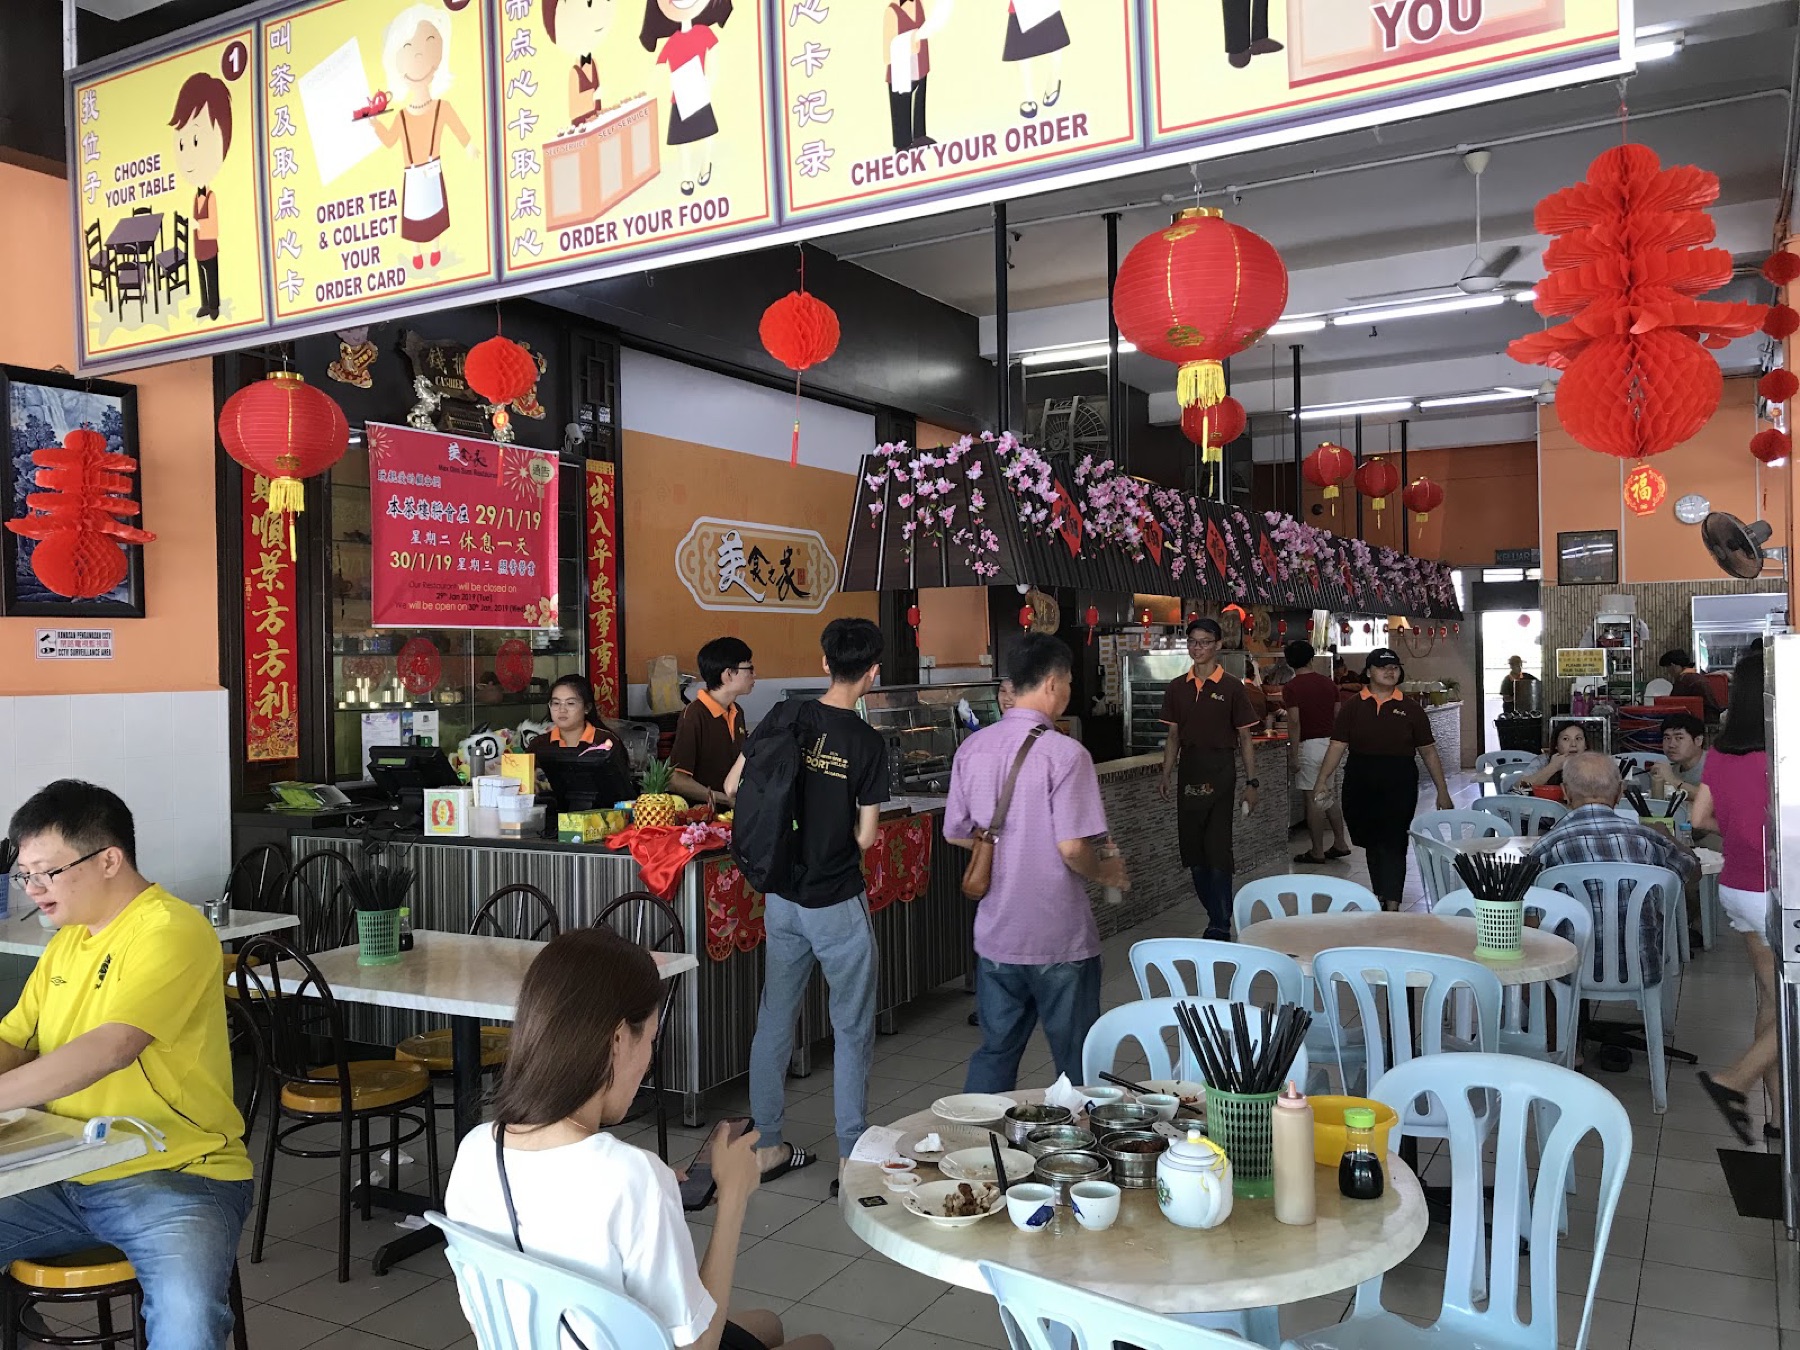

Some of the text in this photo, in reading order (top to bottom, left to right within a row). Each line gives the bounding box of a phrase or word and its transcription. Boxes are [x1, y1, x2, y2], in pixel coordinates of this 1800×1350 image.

[1376, 0, 1483, 50] YOU
[227, 46, 242, 74] 1
[598, 108, 649, 139] SELF SERVICE
[80, 89, 102, 205] 找位子
[269, 21, 304, 303] 叫茶及取点心卡
[851, 112, 1089, 186] CHECK YOUR ORDER
[113, 154, 162, 183] CHOOSE
[105, 173, 176, 208] YOUR TABLE
[316, 188, 398, 225] ORDER TEA
[319, 215, 398, 250] & COLLECT
[559, 196, 730, 253] ORDER YOUR FOOD
[341, 248, 381, 271] YOUR
[315, 267, 406, 303] ORDER CARD
[1630, 474, 1653, 503] 福
[475, 504, 542, 531] 29/1/19
[410, 530, 530, 557] 星期二 休息一天
[389, 551, 452, 573] 30/1/19
[456, 558, 493, 573] 星期三
[457, 581, 470, 591] will
[471, 582, 481, 592] be
[483, 583, 507, 593] closed
[461, 593, 476, 601] 2019
[408, 601, 422, 611] will
[422, 602, 433, 611] be
[434, 603, 456, 613] open
[494, 604, 508, 613] 2019
